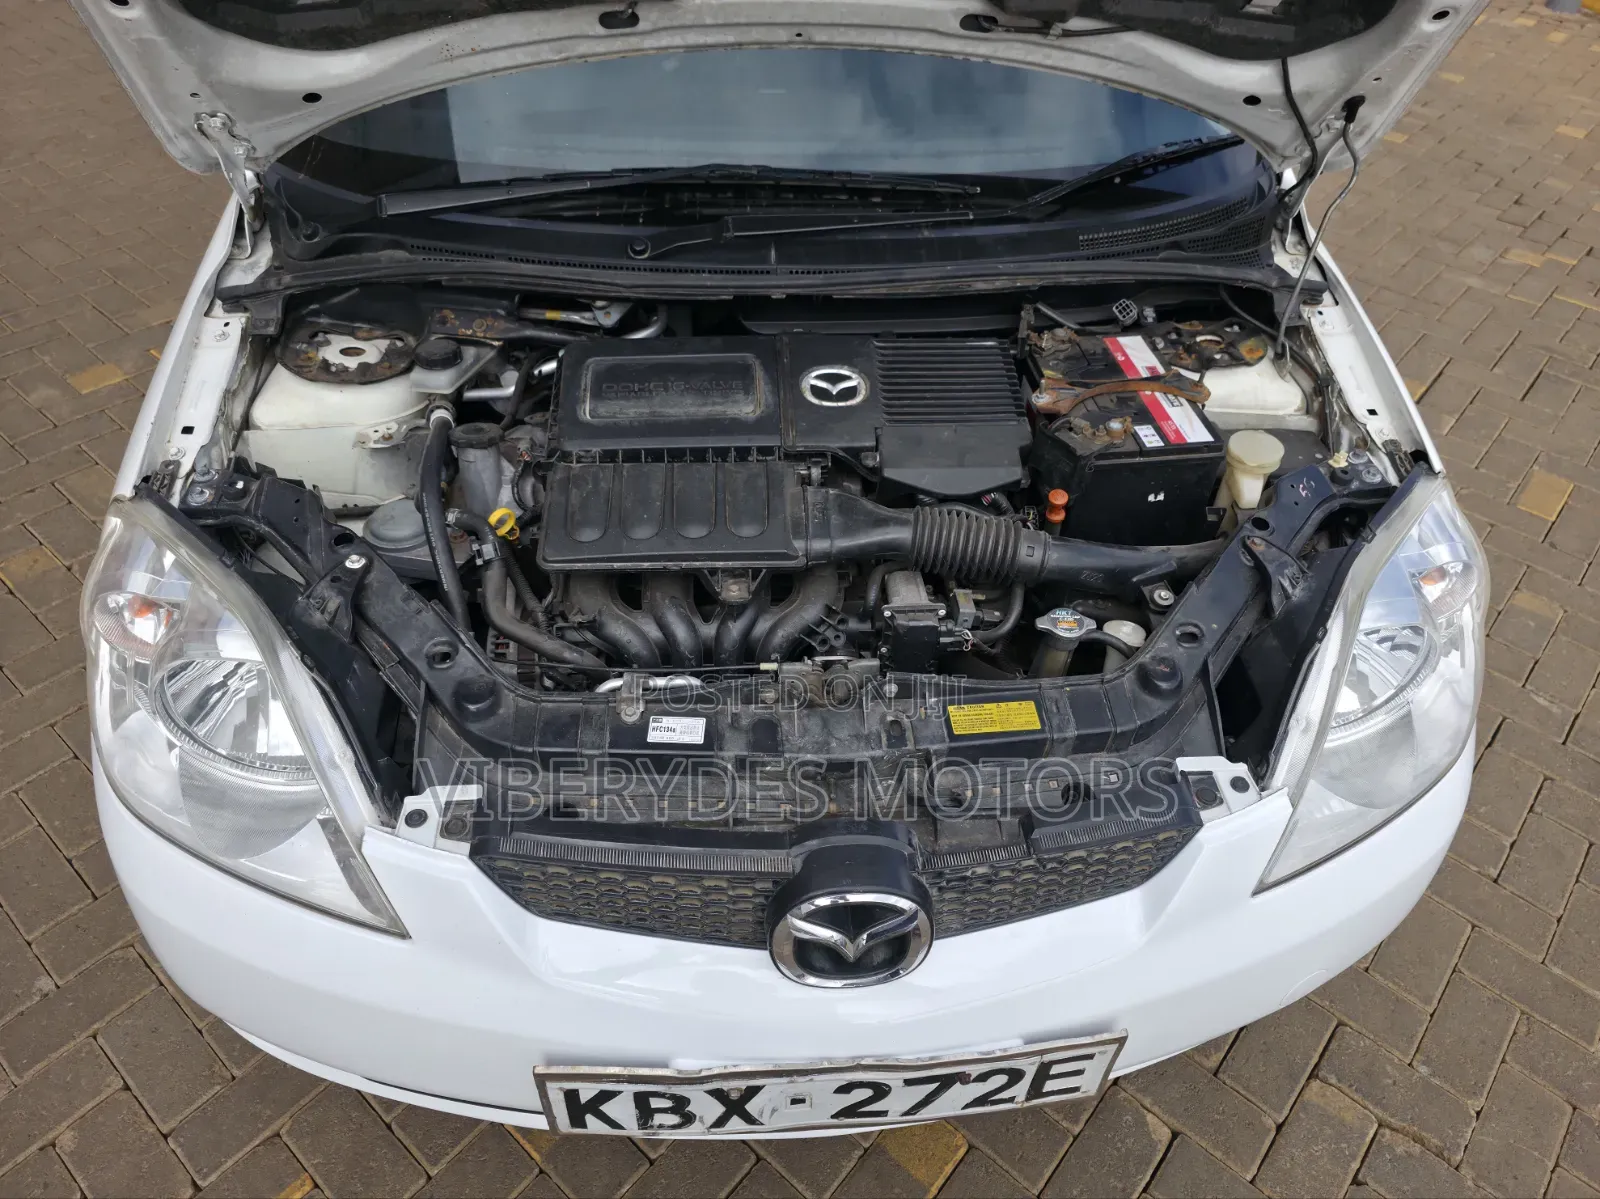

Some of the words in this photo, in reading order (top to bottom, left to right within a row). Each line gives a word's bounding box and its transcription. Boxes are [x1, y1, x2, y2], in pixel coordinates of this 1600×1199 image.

[602, 381, 665, 392] DOHC
[563, 1084, 767, 1131] KBX
[829, 1052, 1097, 1120] 272E
